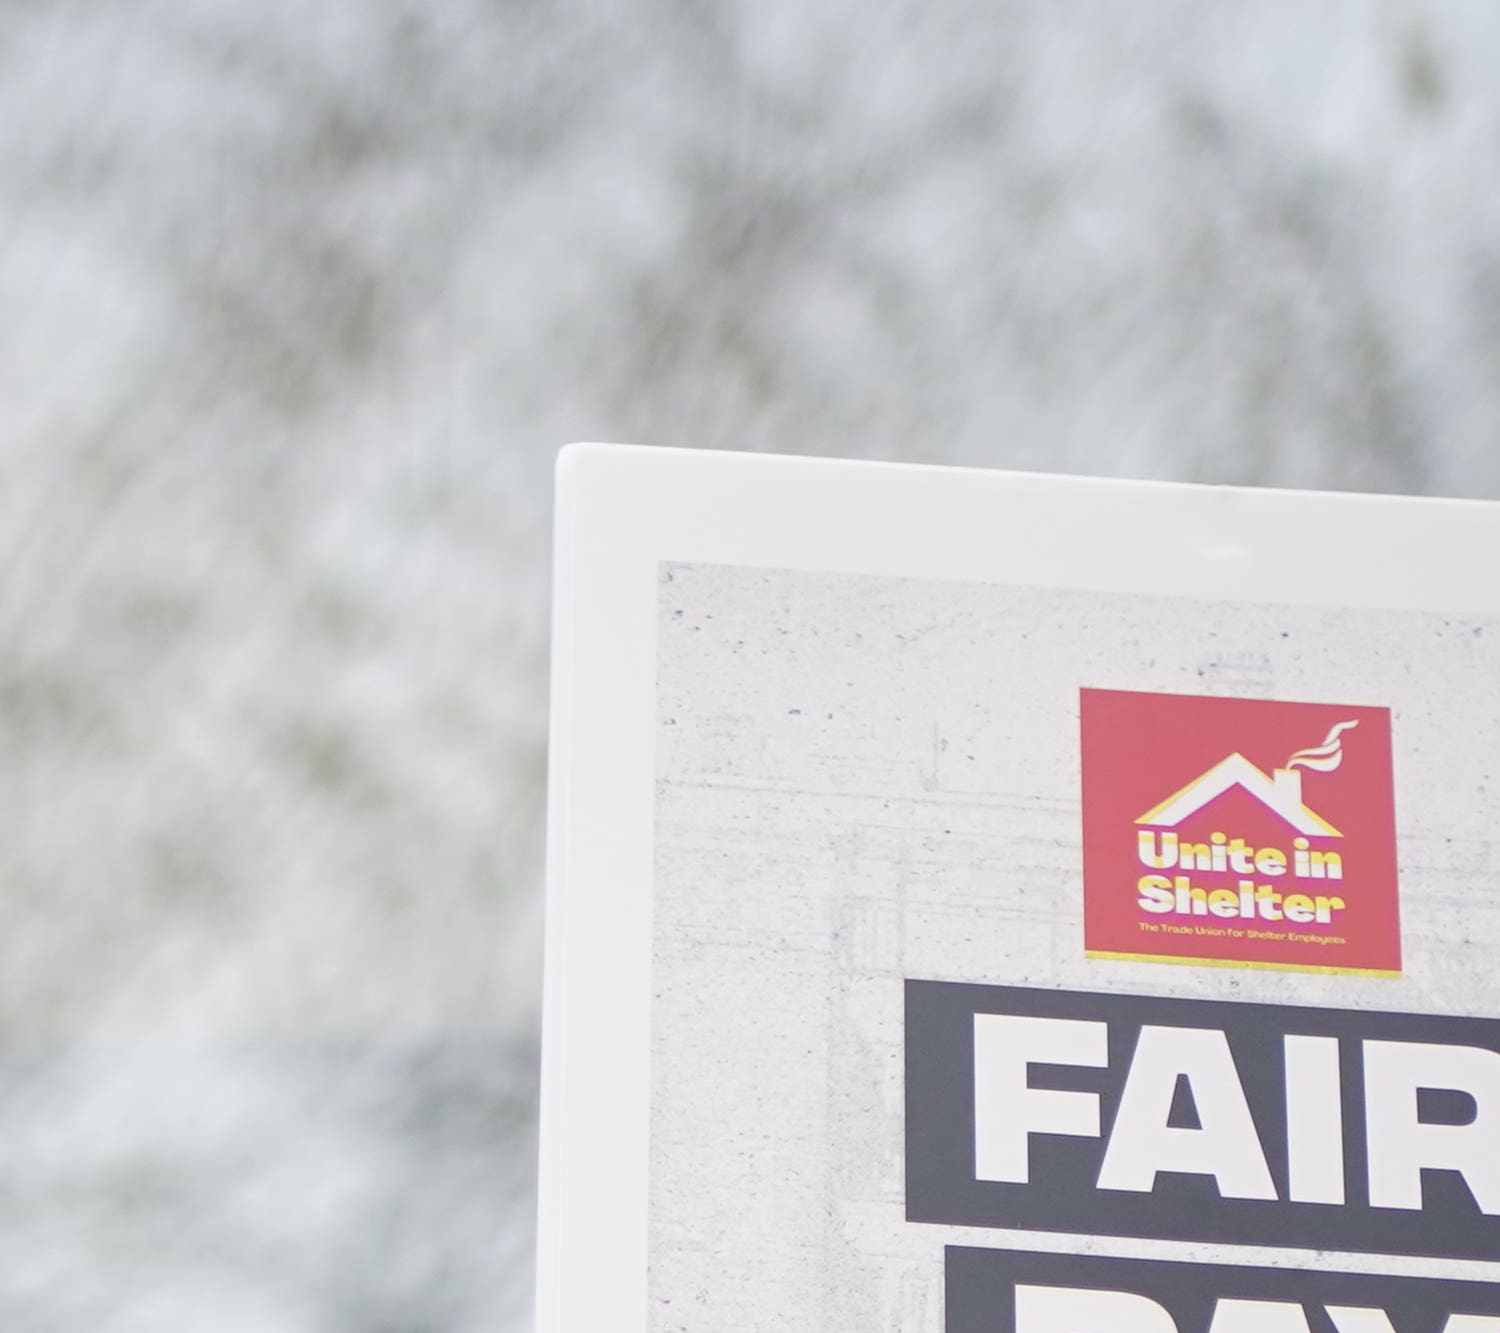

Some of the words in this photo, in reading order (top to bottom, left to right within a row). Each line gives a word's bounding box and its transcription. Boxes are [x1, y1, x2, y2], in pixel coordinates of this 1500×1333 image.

[1137, 830, 1288, 877] Unite
[1293, 836, 1343, 880] in
[1137, 874, 1346, 924] Shelter
[1138, 921, 1160, 933] The
[1160, 923, 1194, 935] Trade
[1195, 926, 1226, 937] Union
[1226, 927, 1246, 938] for
[1246, 929, 1287, 941] Shelter
[1287, 932, 1347, 946] Employees
